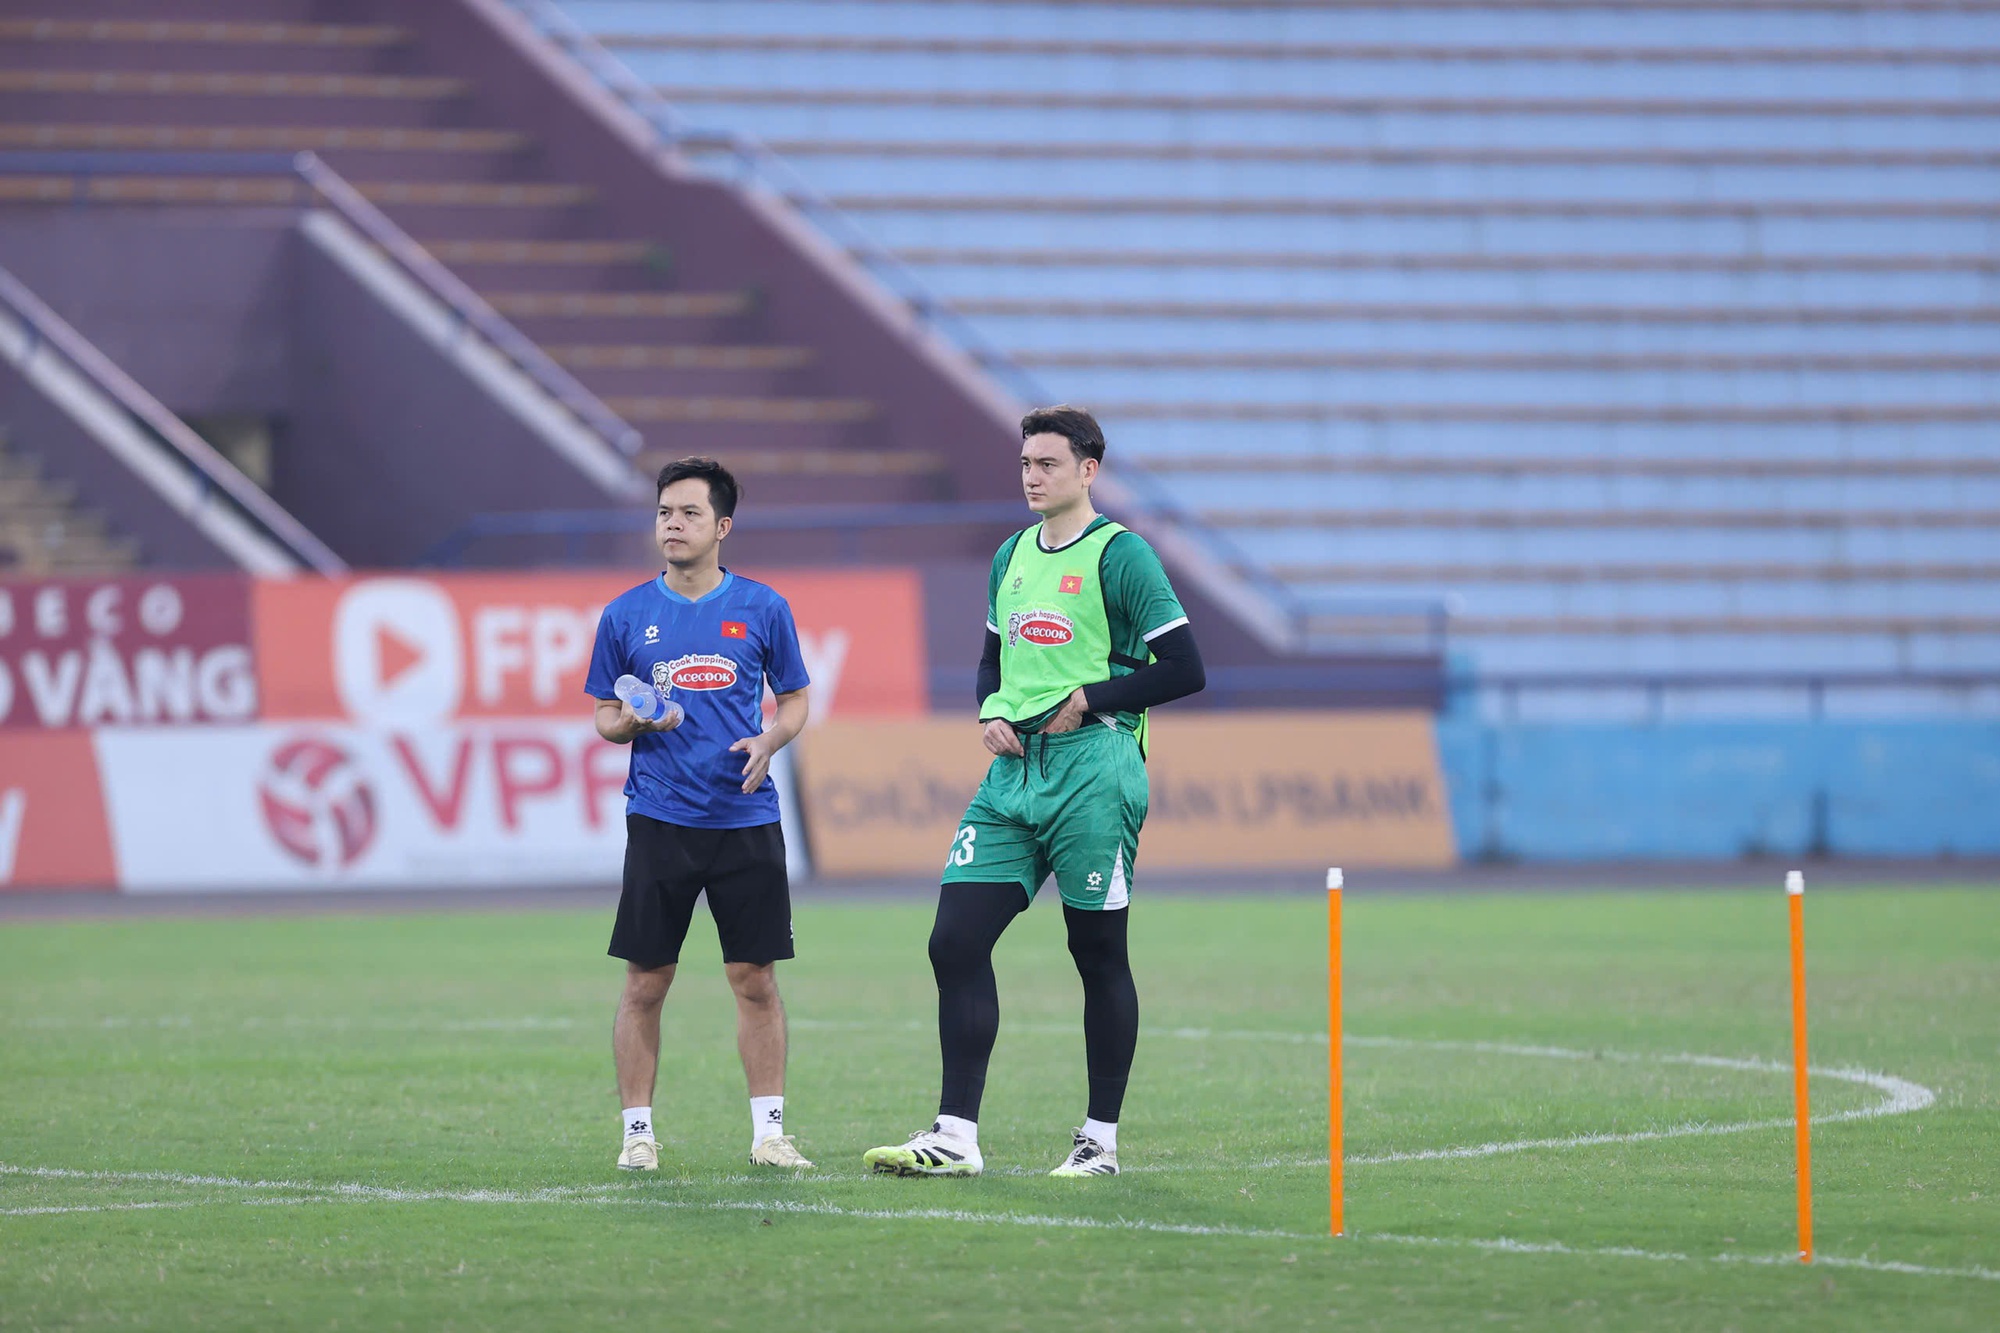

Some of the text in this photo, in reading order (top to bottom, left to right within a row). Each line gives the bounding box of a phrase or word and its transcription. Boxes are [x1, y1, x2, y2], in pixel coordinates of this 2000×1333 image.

[1021, 611, 1073, 627] Cook happiness
[670, 655, 737, 670] Cook happiness
